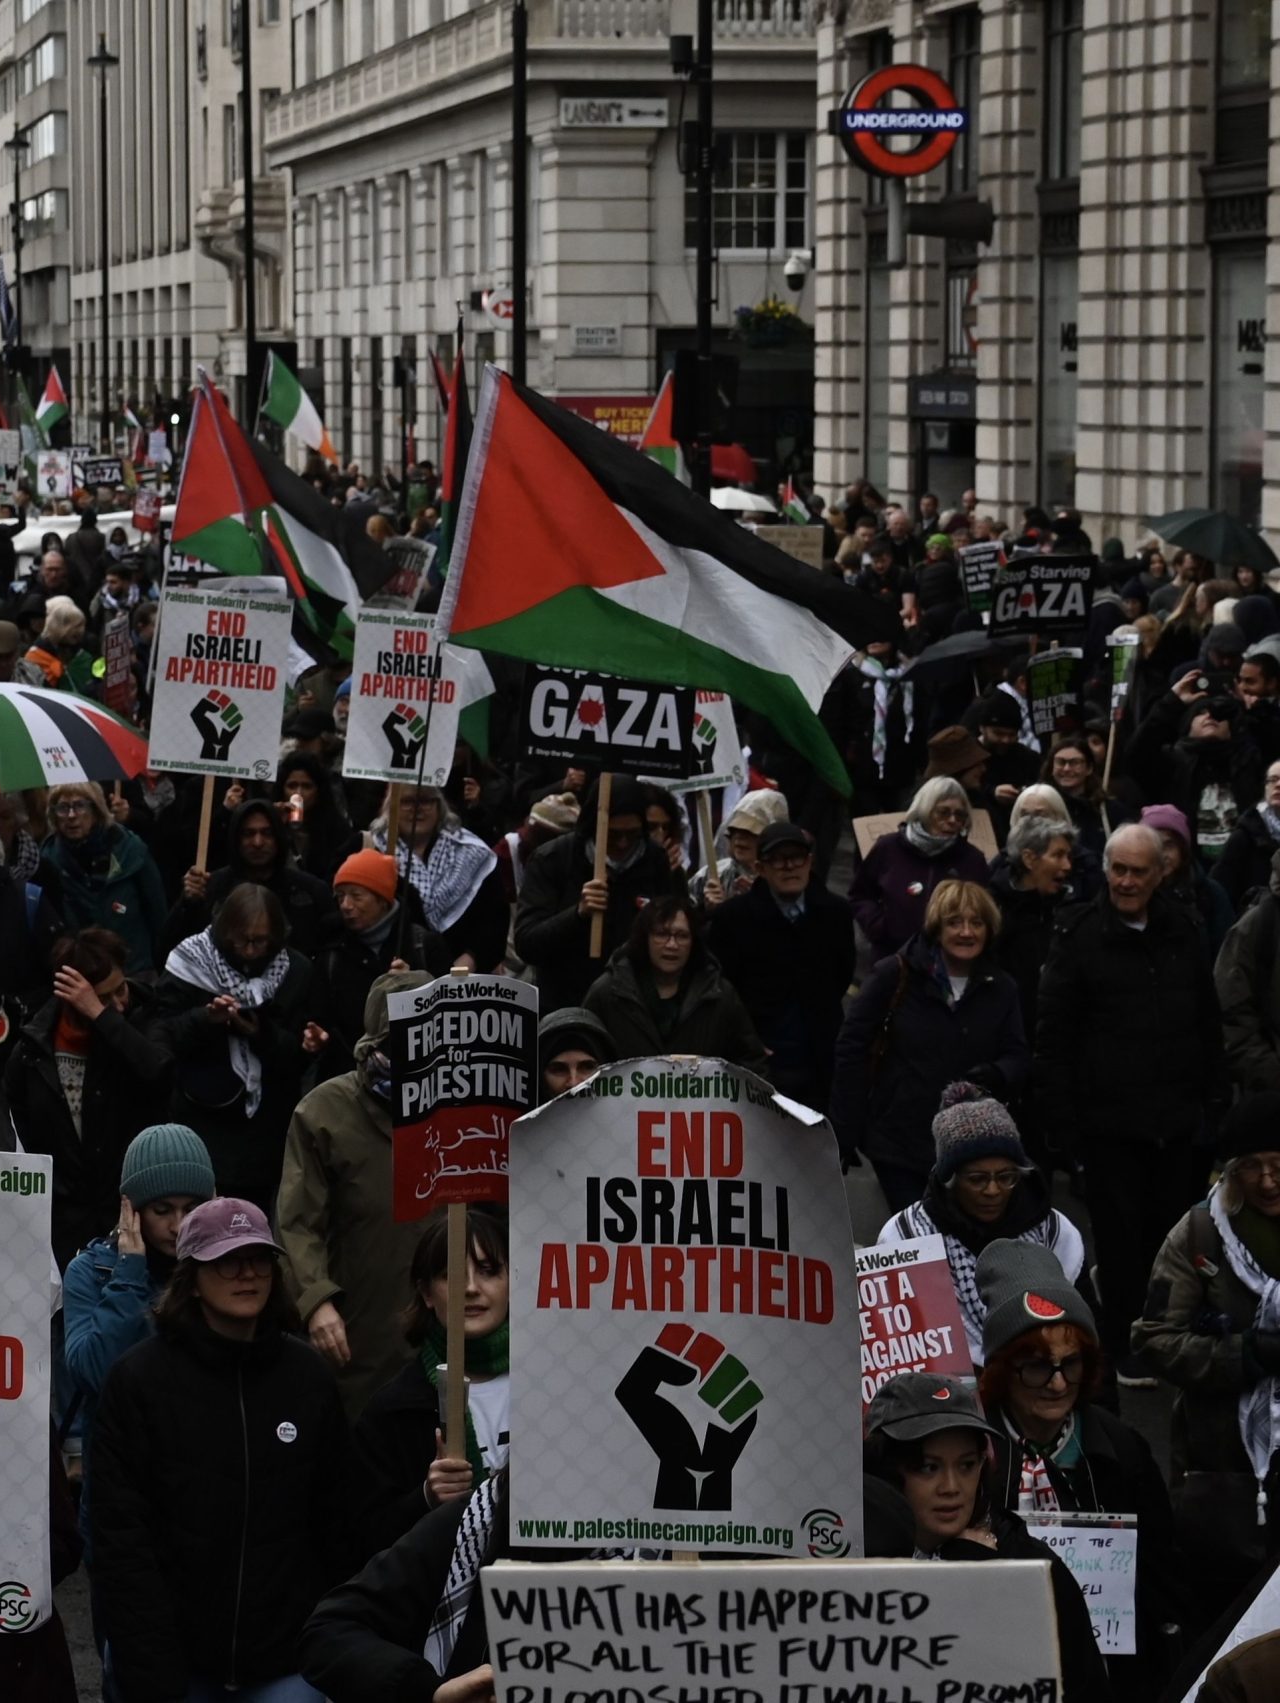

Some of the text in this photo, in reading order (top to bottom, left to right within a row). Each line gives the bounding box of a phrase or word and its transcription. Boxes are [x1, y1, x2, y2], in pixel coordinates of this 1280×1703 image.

[846, 112, 964, 129] UNDERGROUND
[1029, 565, 1091, 580] Starving
[165, 591, 292, 614] Palestine Solidarity Campaign
[995, 582, 1086, 622] GAZA
[206, 609, 246, 637] END
[357, 613, 391, 625] Palestine
[185, 633, 262, 664] ISRAELI
[394, 629, 428, 654] END
[165, 656, 277, 691] APARTHEID
[377, 651, 443, 679] ISRAELI
[360, 672, 455, 704] APARTHEID
[529, 679, 682, 751] GAZA
[414, 982, 518, 1013] Socialist Worker
[407, 1008, 523, 1062] FREEDOM
[447, 1045, 470, 1063] for
[401, 1062, 529, 1118] PALESTINE
[631, 1071, 740, 1103] Solidarity
[637, 1110, 744, 1178] END
[586, 1176, 790, 1252] ISRAELI
[865, 1248, 920, 1269] Worker
[536, 1243, 835, 1326] APARTHEID
[859, 1271, 915, 1309] OT A
[878, 1303, 912, 1336] TO
[860, 1325, 953, 1373] AGAINST
[518, 1517, 794, 1549] www.palestinecampaign.org
[808, 1525, 843, 1547] PSC
[1089, 1537, 1114, 1548] THE
[491, 1584, 931, 1637] WHAT HAS HAPPENED
[496, 1634, 960, 1678] FOR ALL THE FUTURE
